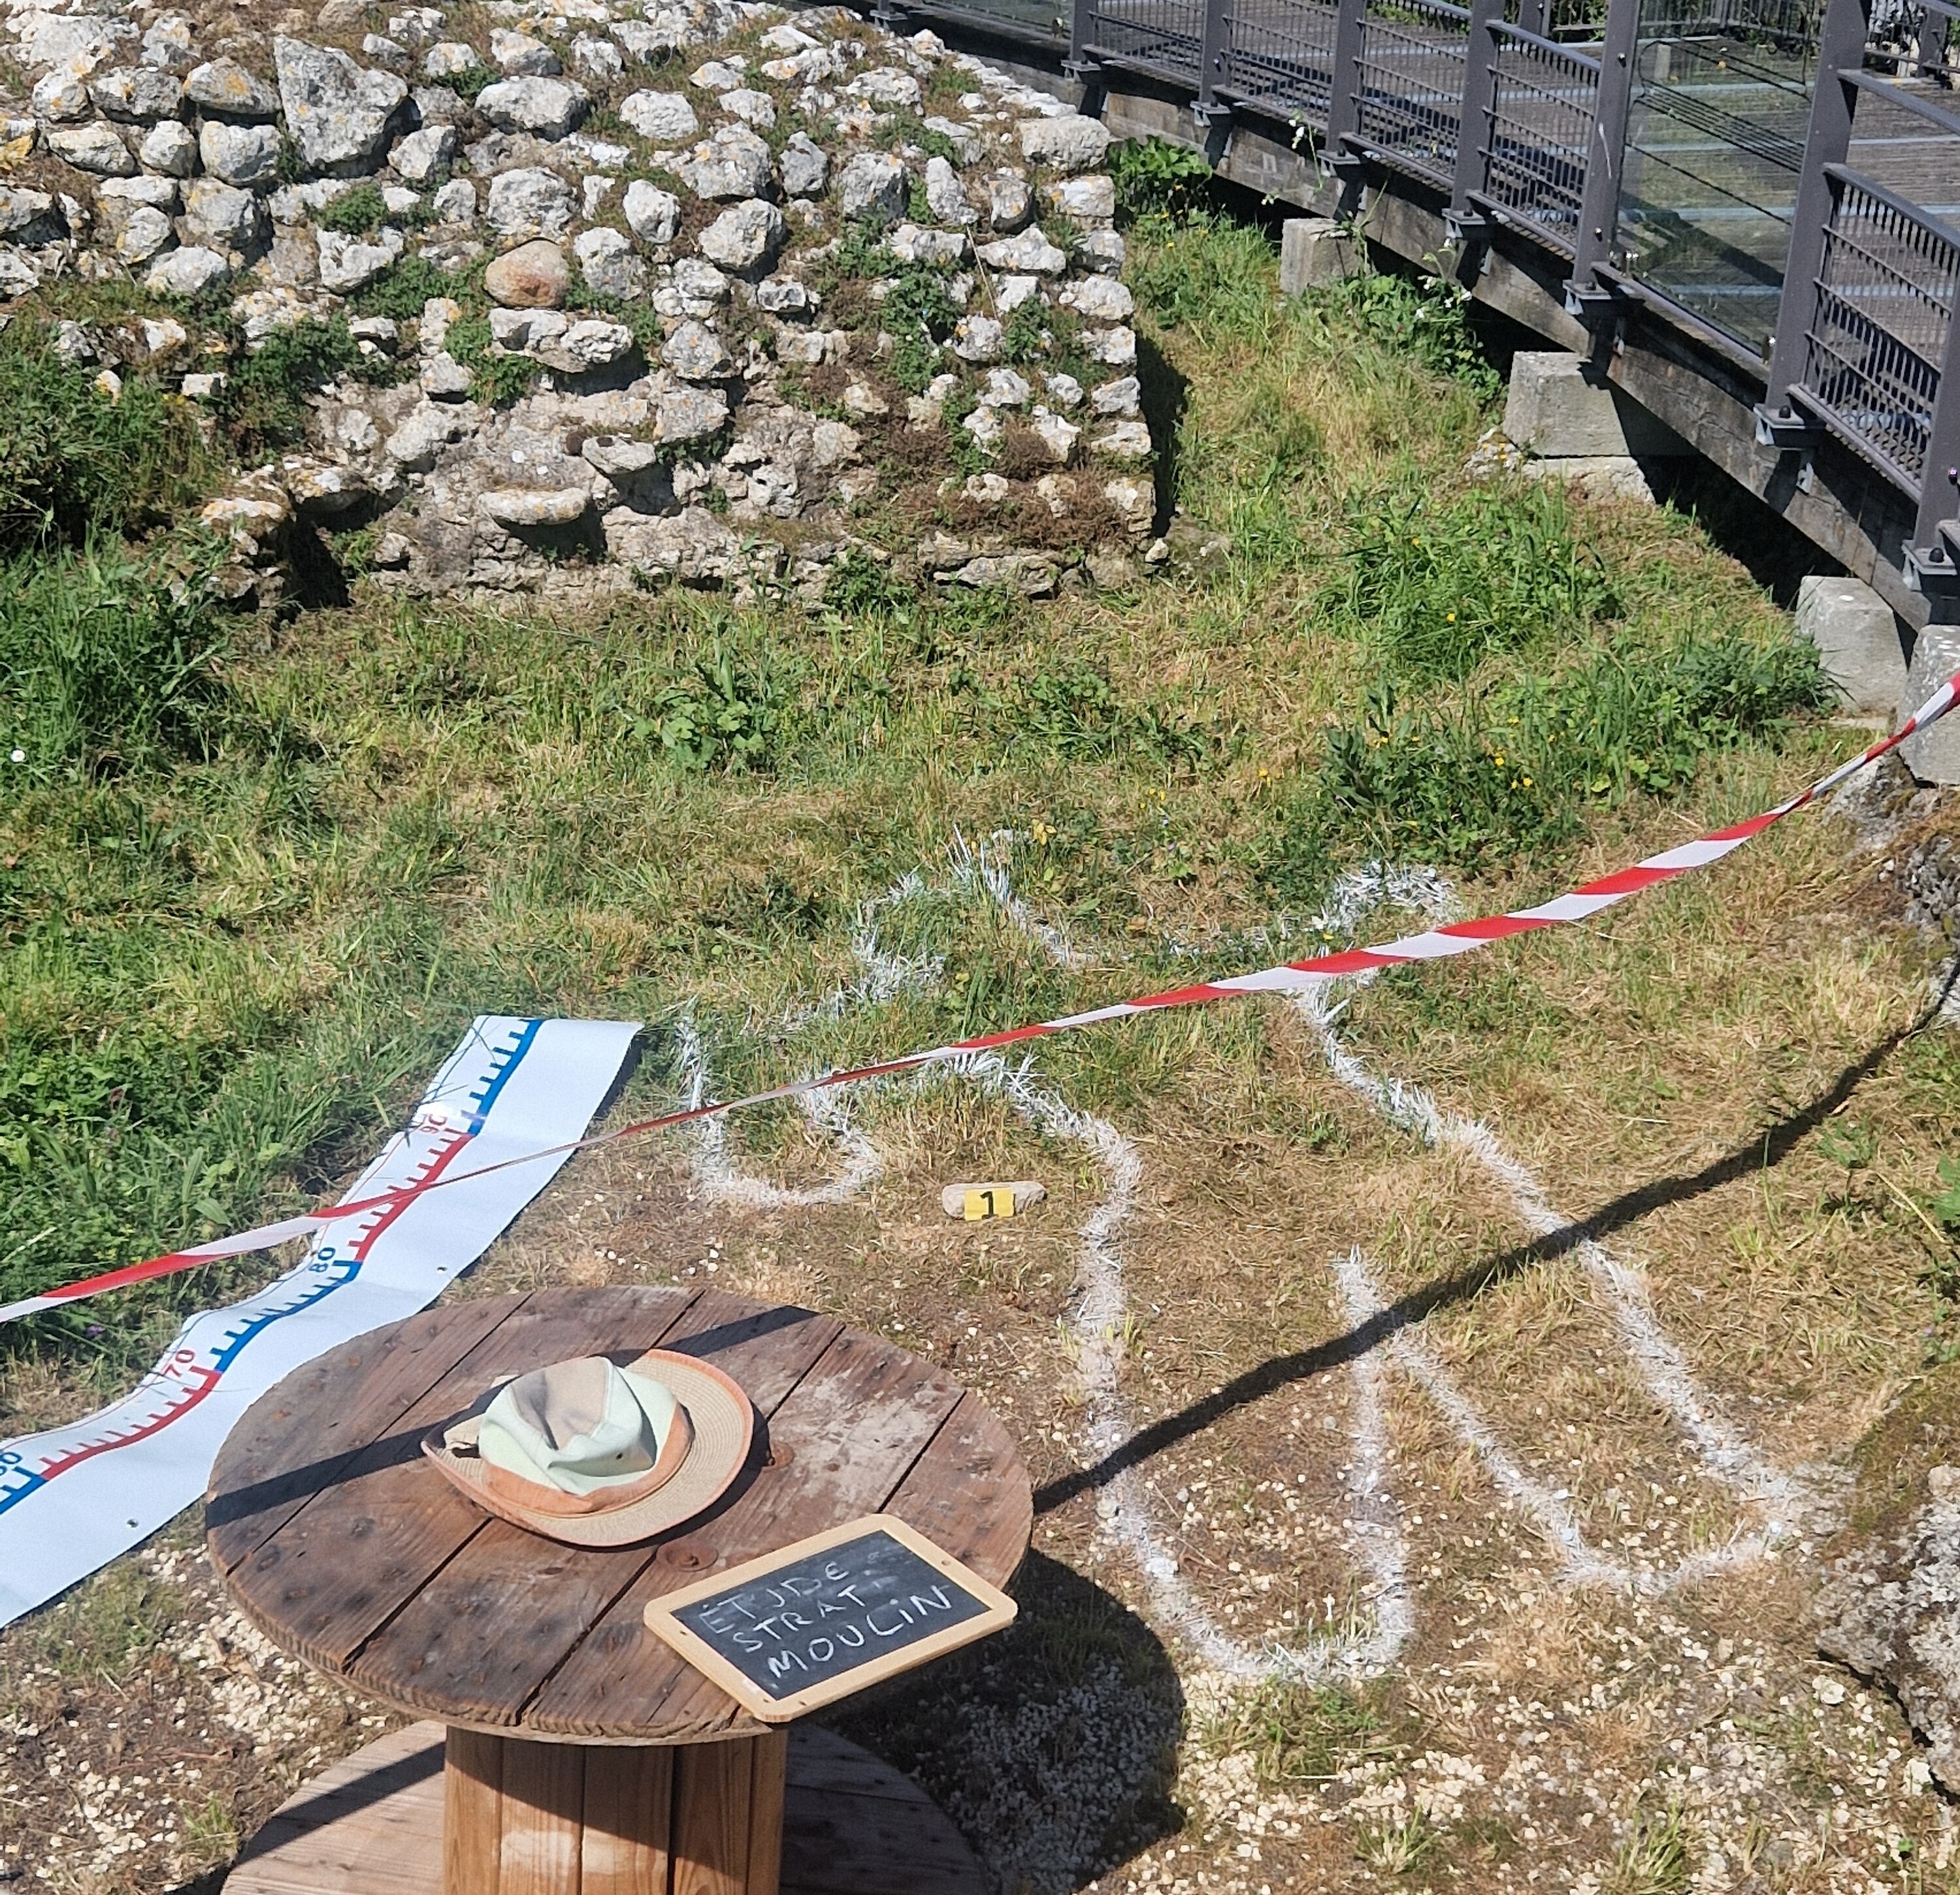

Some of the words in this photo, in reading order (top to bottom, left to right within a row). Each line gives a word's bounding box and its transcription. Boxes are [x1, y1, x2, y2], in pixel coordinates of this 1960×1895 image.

[979, 1191, 999, 1220] 1
[309, 1247, 336, 1272] 80
[163, 1350, 195, 1378] 70
